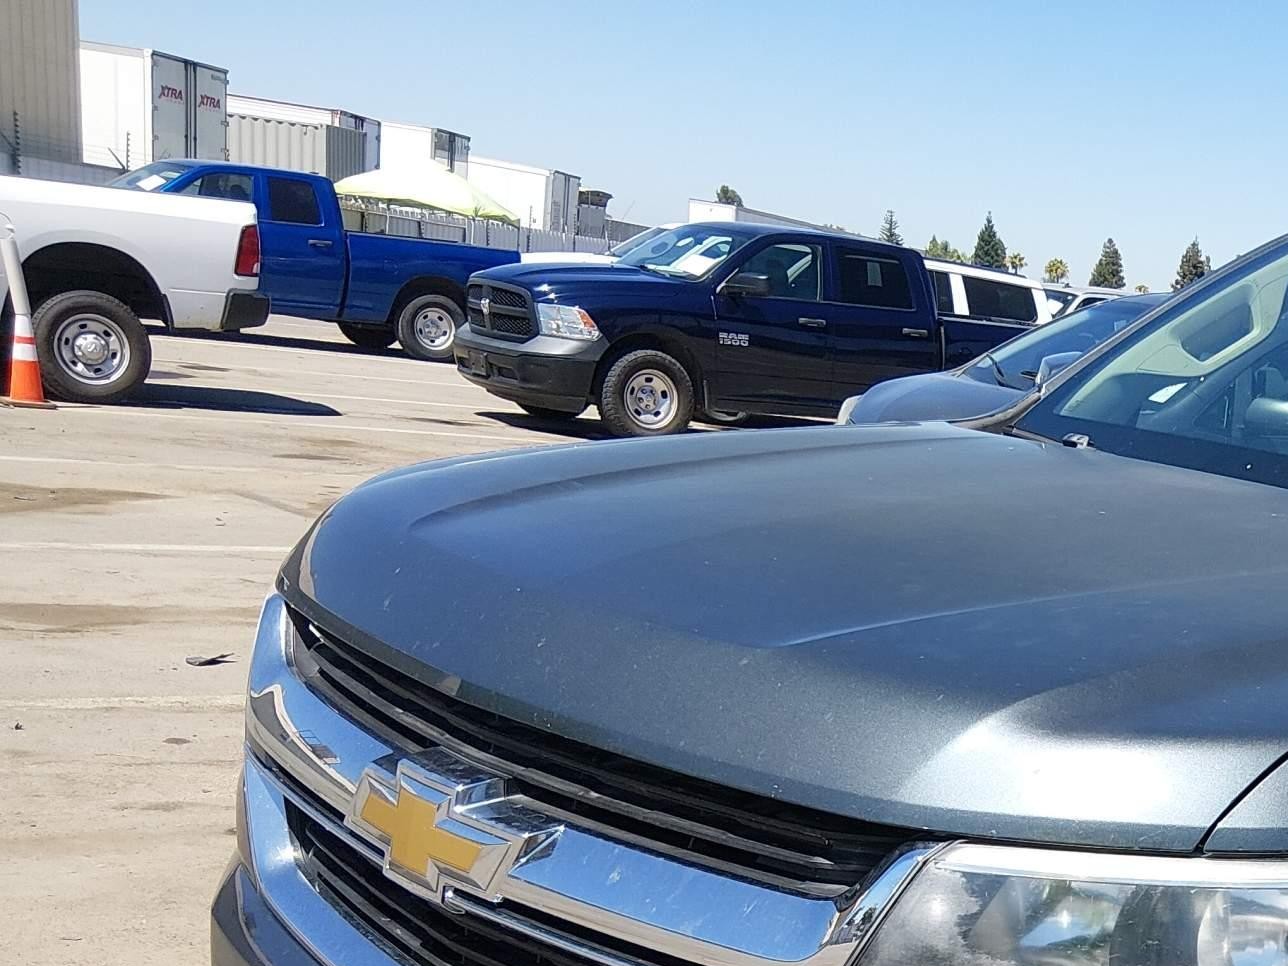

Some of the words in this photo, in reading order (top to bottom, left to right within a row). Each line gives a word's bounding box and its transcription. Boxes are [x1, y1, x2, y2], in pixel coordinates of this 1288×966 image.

[159, 85, 183, 101] XTRA
[198, 94, 221, 109] XTRA
[719, 338, 749, 346] 1500
